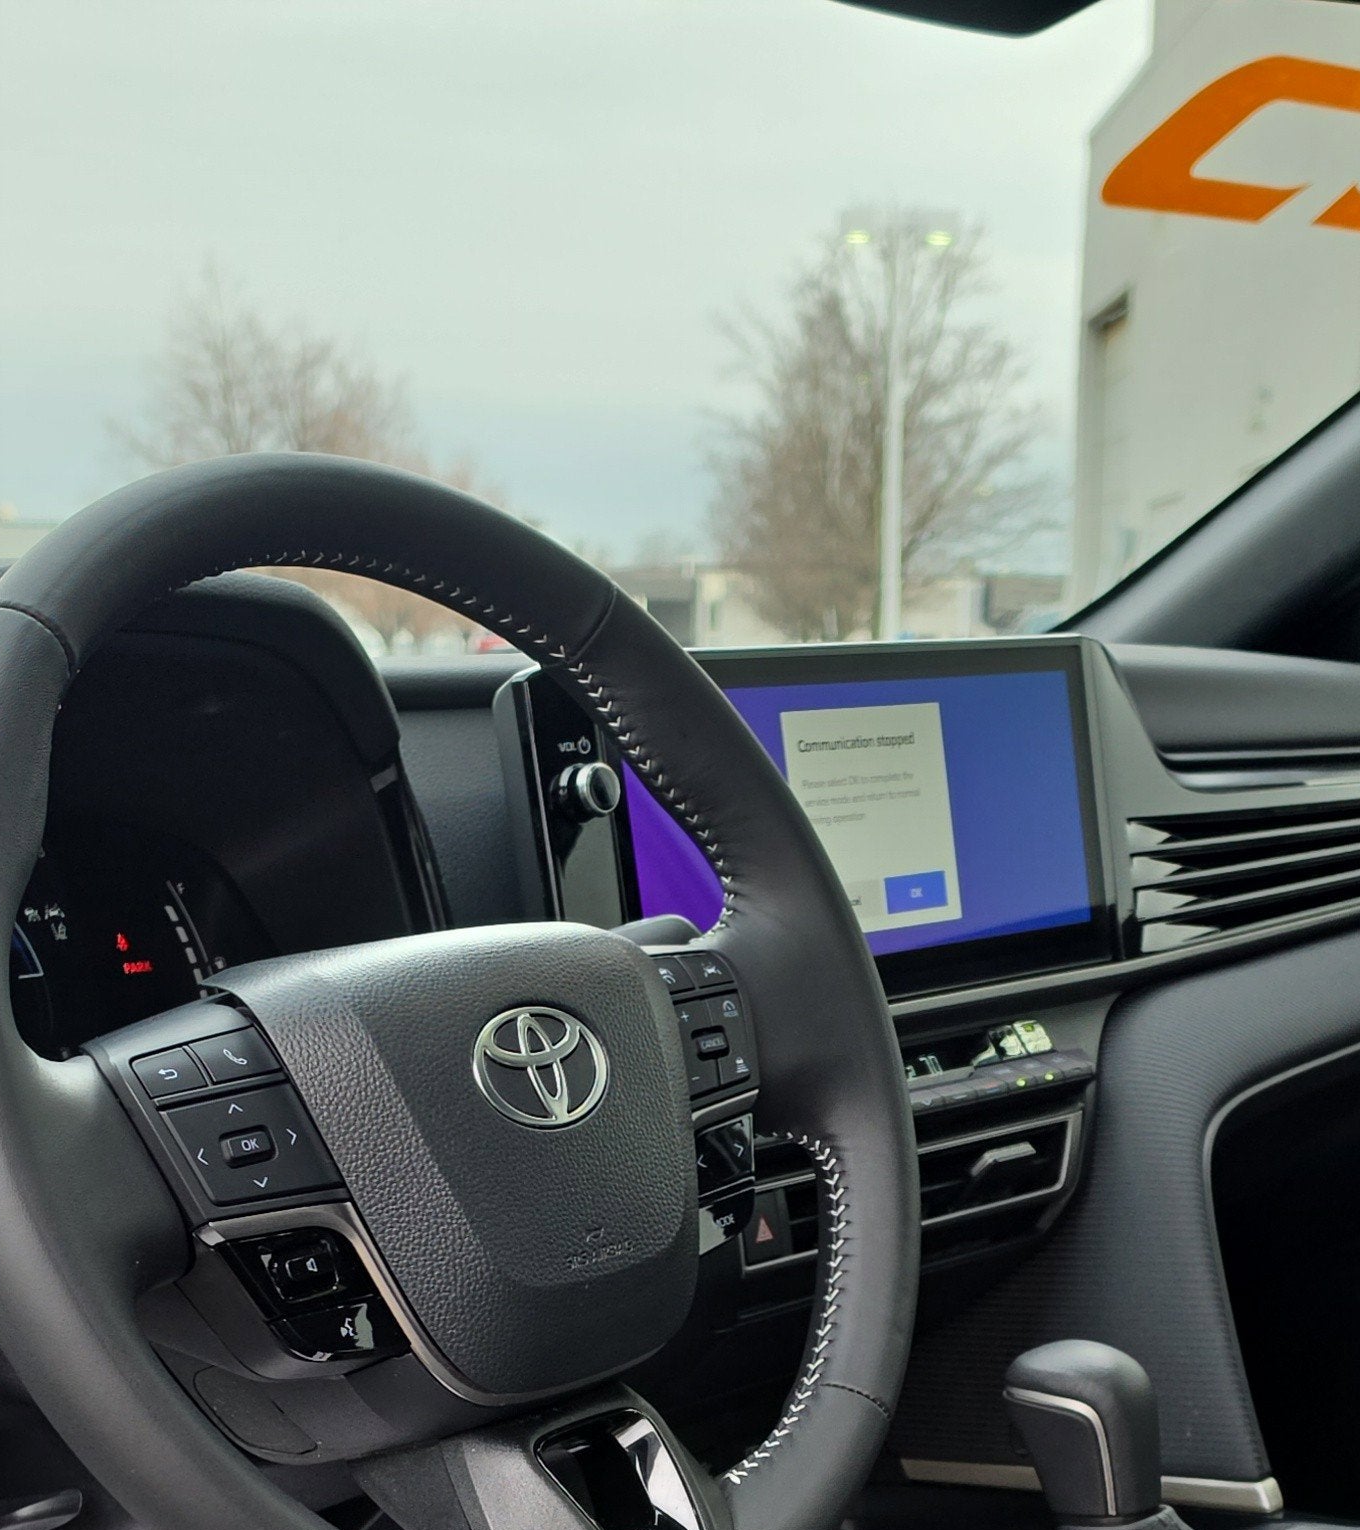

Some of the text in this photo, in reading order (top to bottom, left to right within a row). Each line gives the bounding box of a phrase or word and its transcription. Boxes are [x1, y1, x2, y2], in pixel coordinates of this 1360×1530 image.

[797, 731, 916, 753] Communication stopped
[241, 1138, 260, 1151] OK
